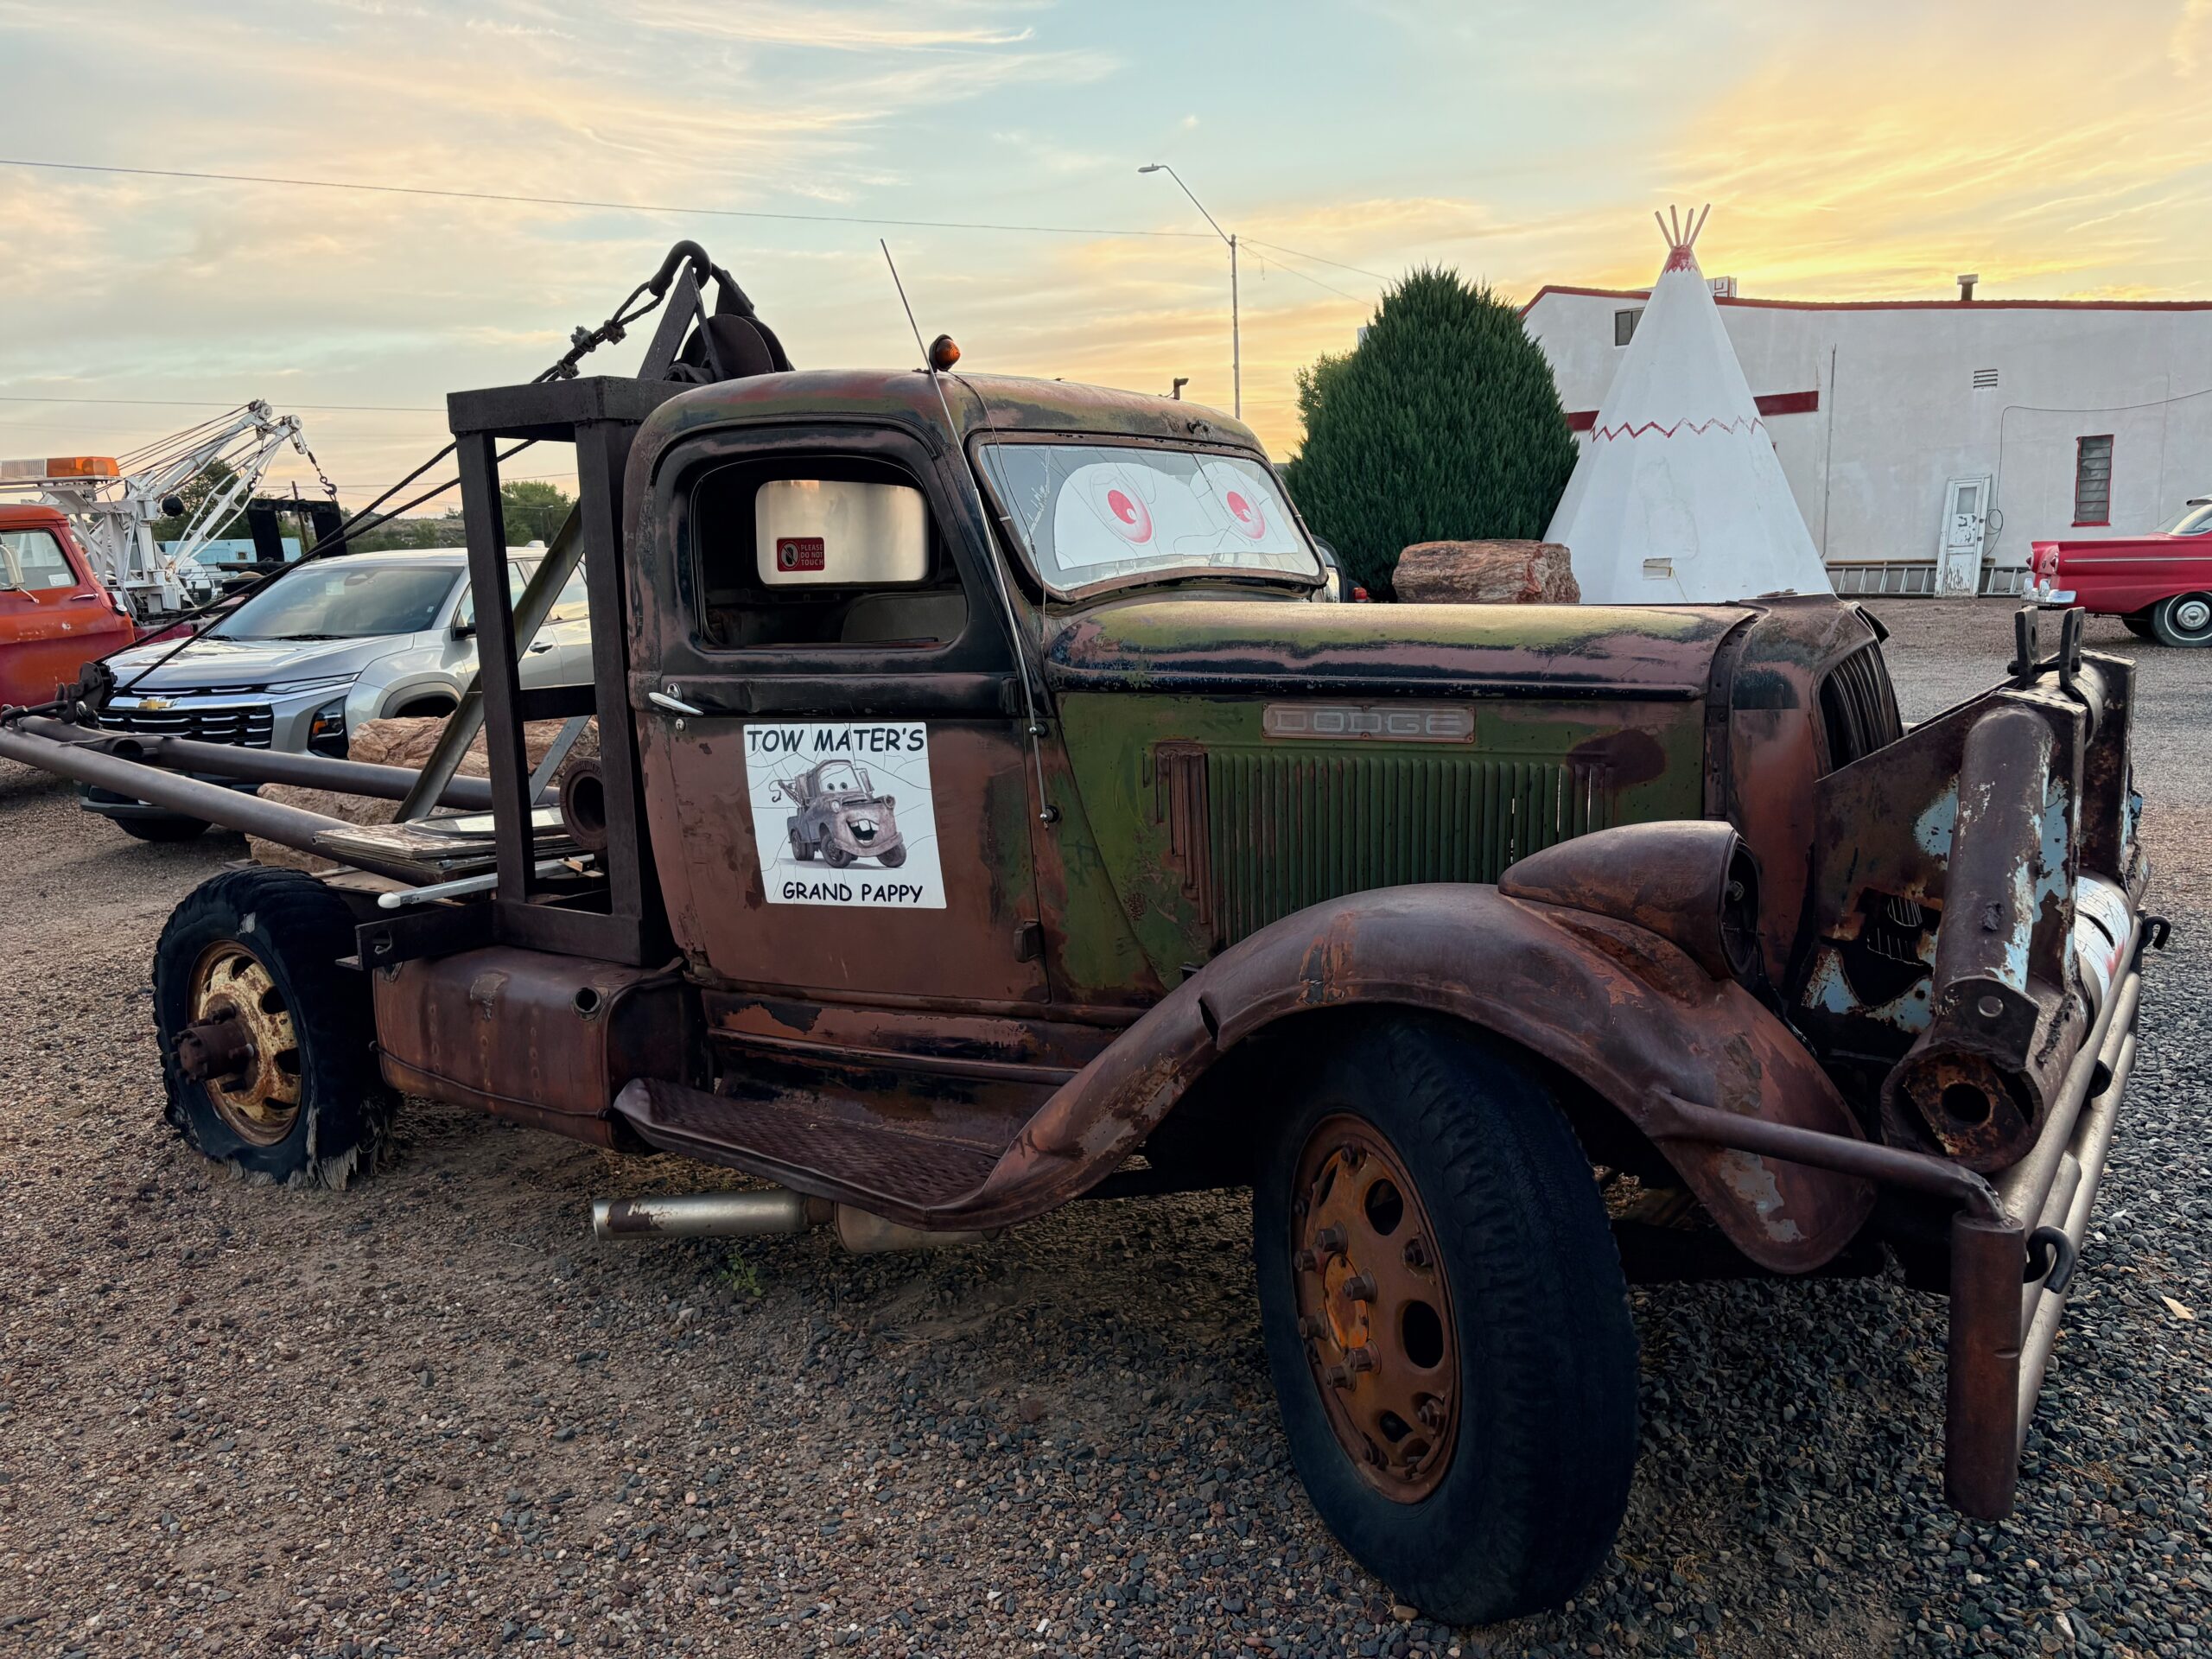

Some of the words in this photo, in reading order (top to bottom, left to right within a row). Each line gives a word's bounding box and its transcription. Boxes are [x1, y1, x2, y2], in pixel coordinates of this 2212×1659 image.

[1274, 710, 1463, 735] DODGE
[747, 729, 804, 752] TOW
[814, 728, 925, 753] MATER'S
[783, 881, 852, 901] GRAND
[861, 883, 924, 903] PAPPY
